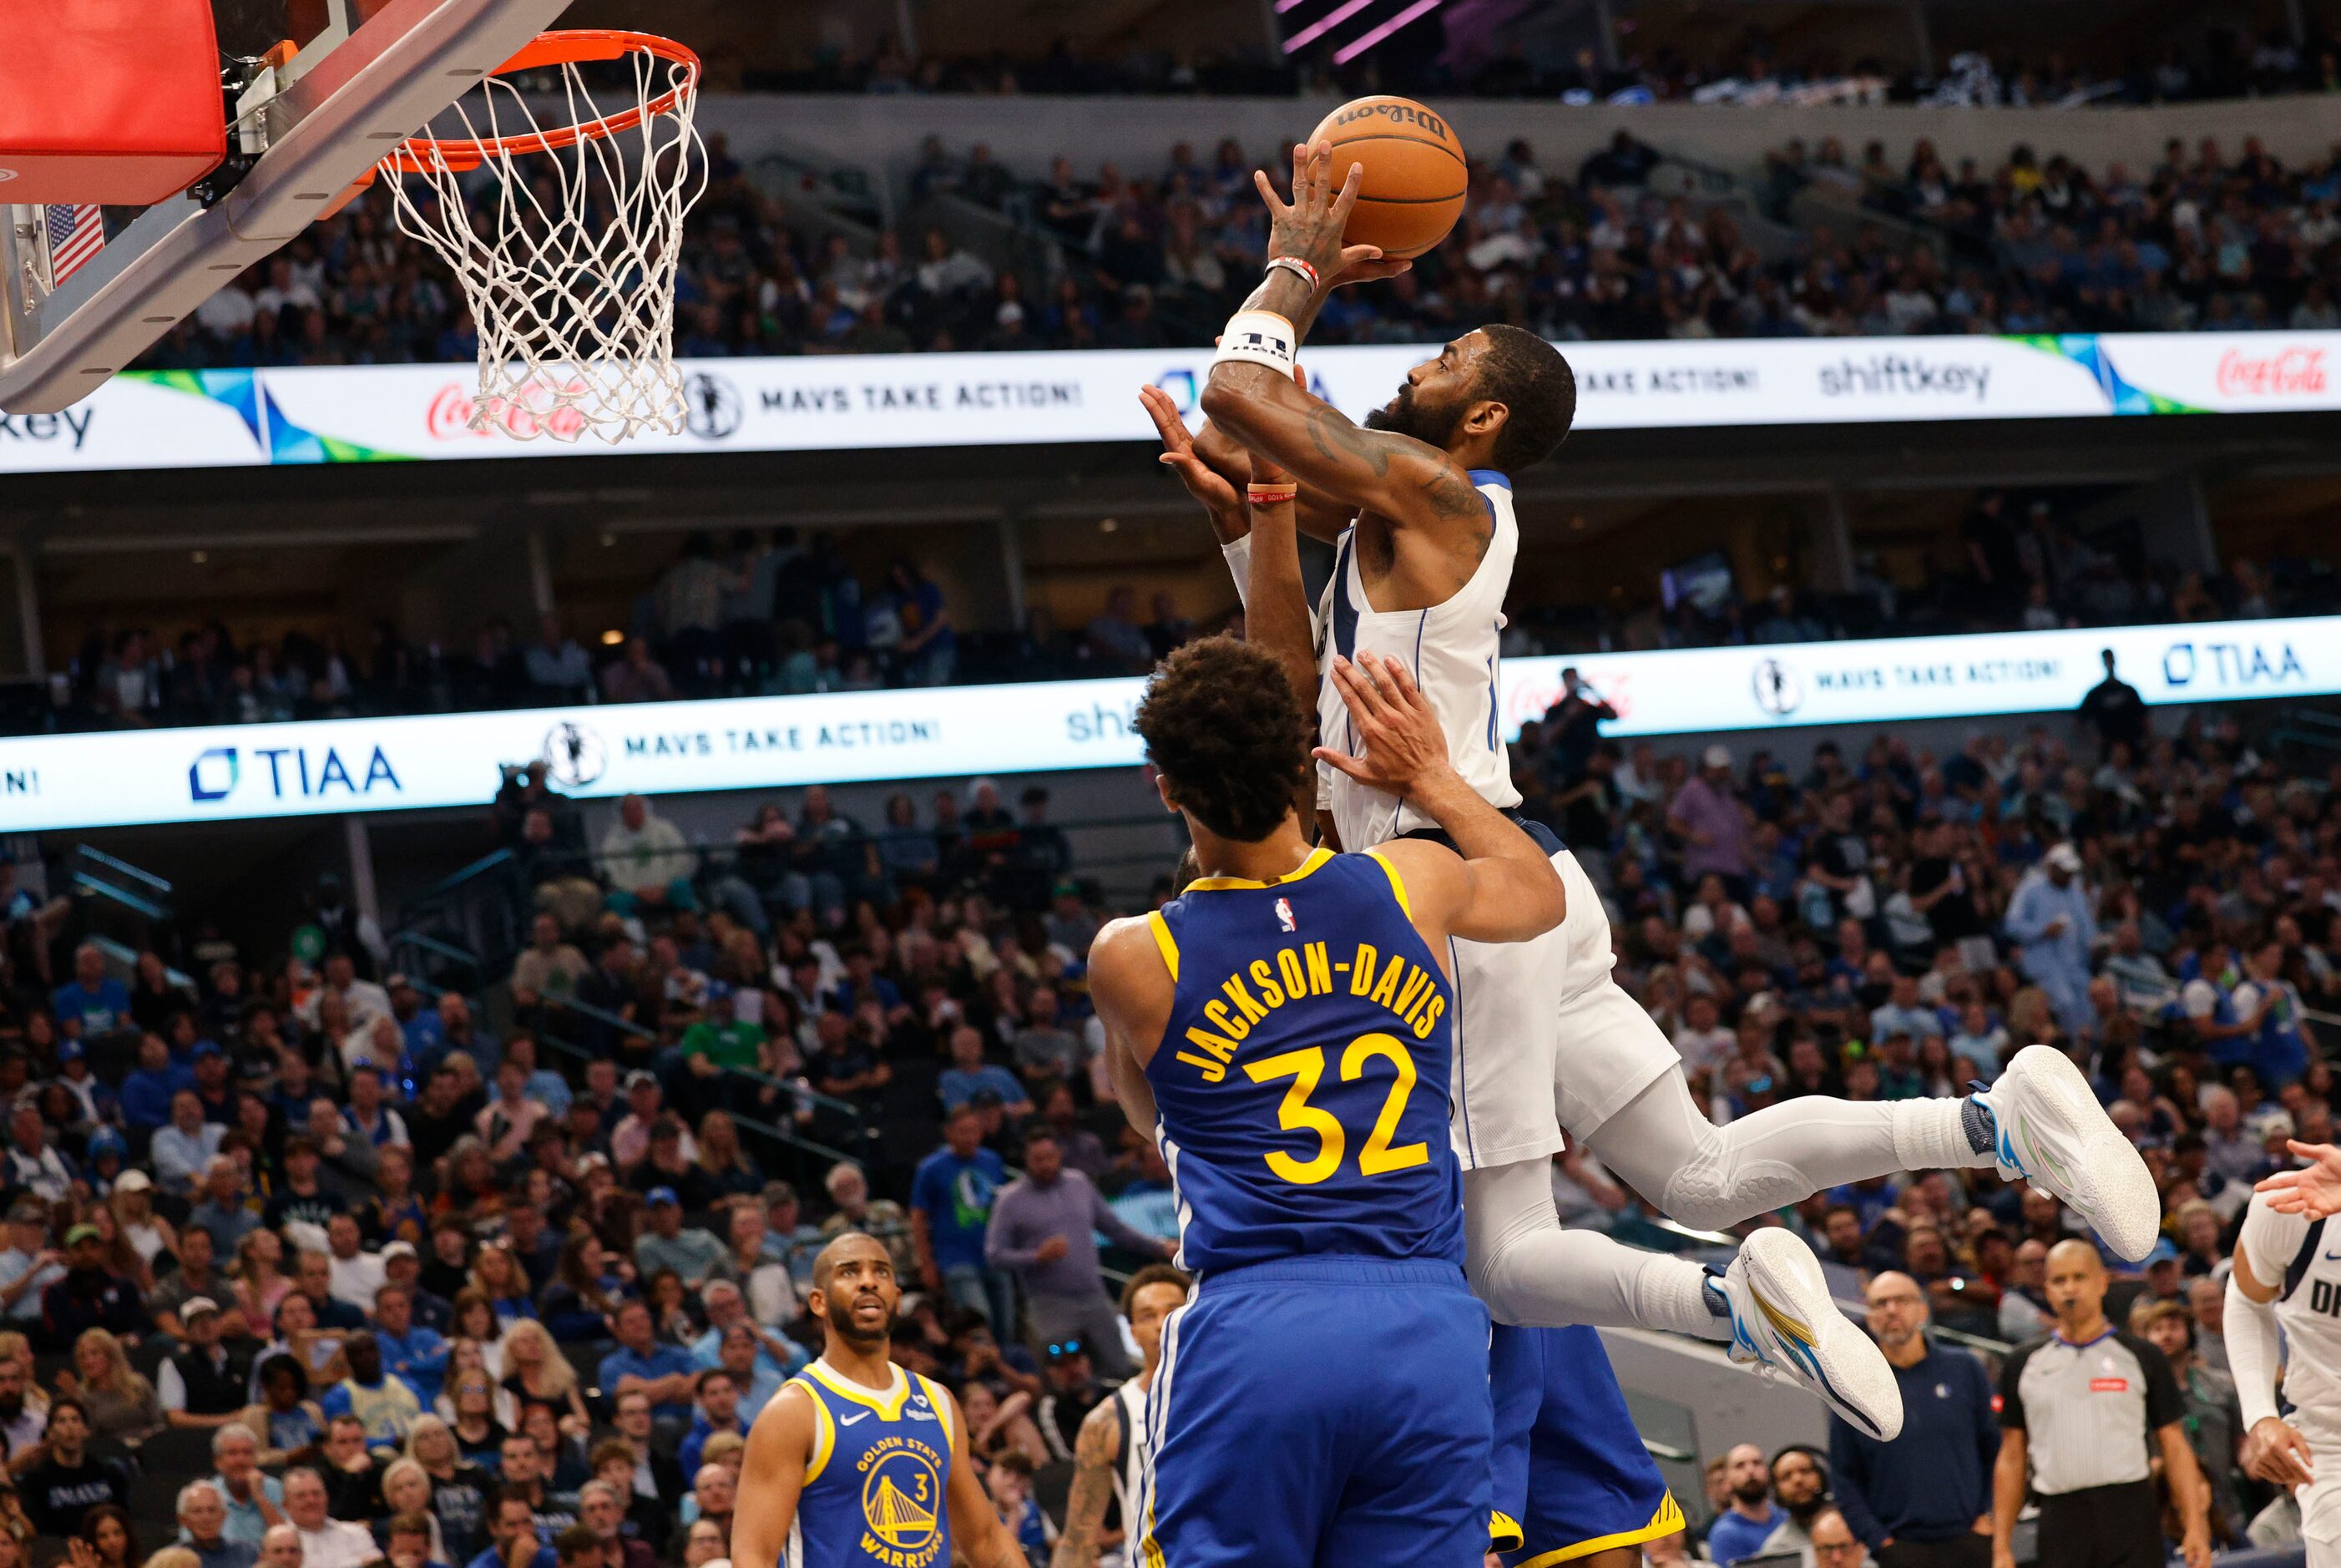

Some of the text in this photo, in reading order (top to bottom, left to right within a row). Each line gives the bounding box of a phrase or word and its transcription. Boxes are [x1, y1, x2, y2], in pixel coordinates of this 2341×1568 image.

[1337, 104, 1447, 141] Wilson
[1818, 353, 1990, 401] shiftkey
[2217, 346, 2327, 397] Coca-Cola
[761, 380, 1082, 412] MAVS TAKE ACTION!
[1815, 668, 1883, 690] MAVS
[1895, 665, 1954, 686] TAKE
[2207, 642, 2307, 685] TIAA
[624, 719, 941, 758] MAVS TAKE ACTION!
[254, 744, 402, 798] TIAA
[1176, 940, 1446, 1083] JACKSON-DAVIS
[1241, 1032, 1430, 1185] 32
[857, 1436, 943, 1472] GOLDEN STATE
[913, 1473, 928, 1502] 3
[860, 1530, 943, 1568] WARRIORS
